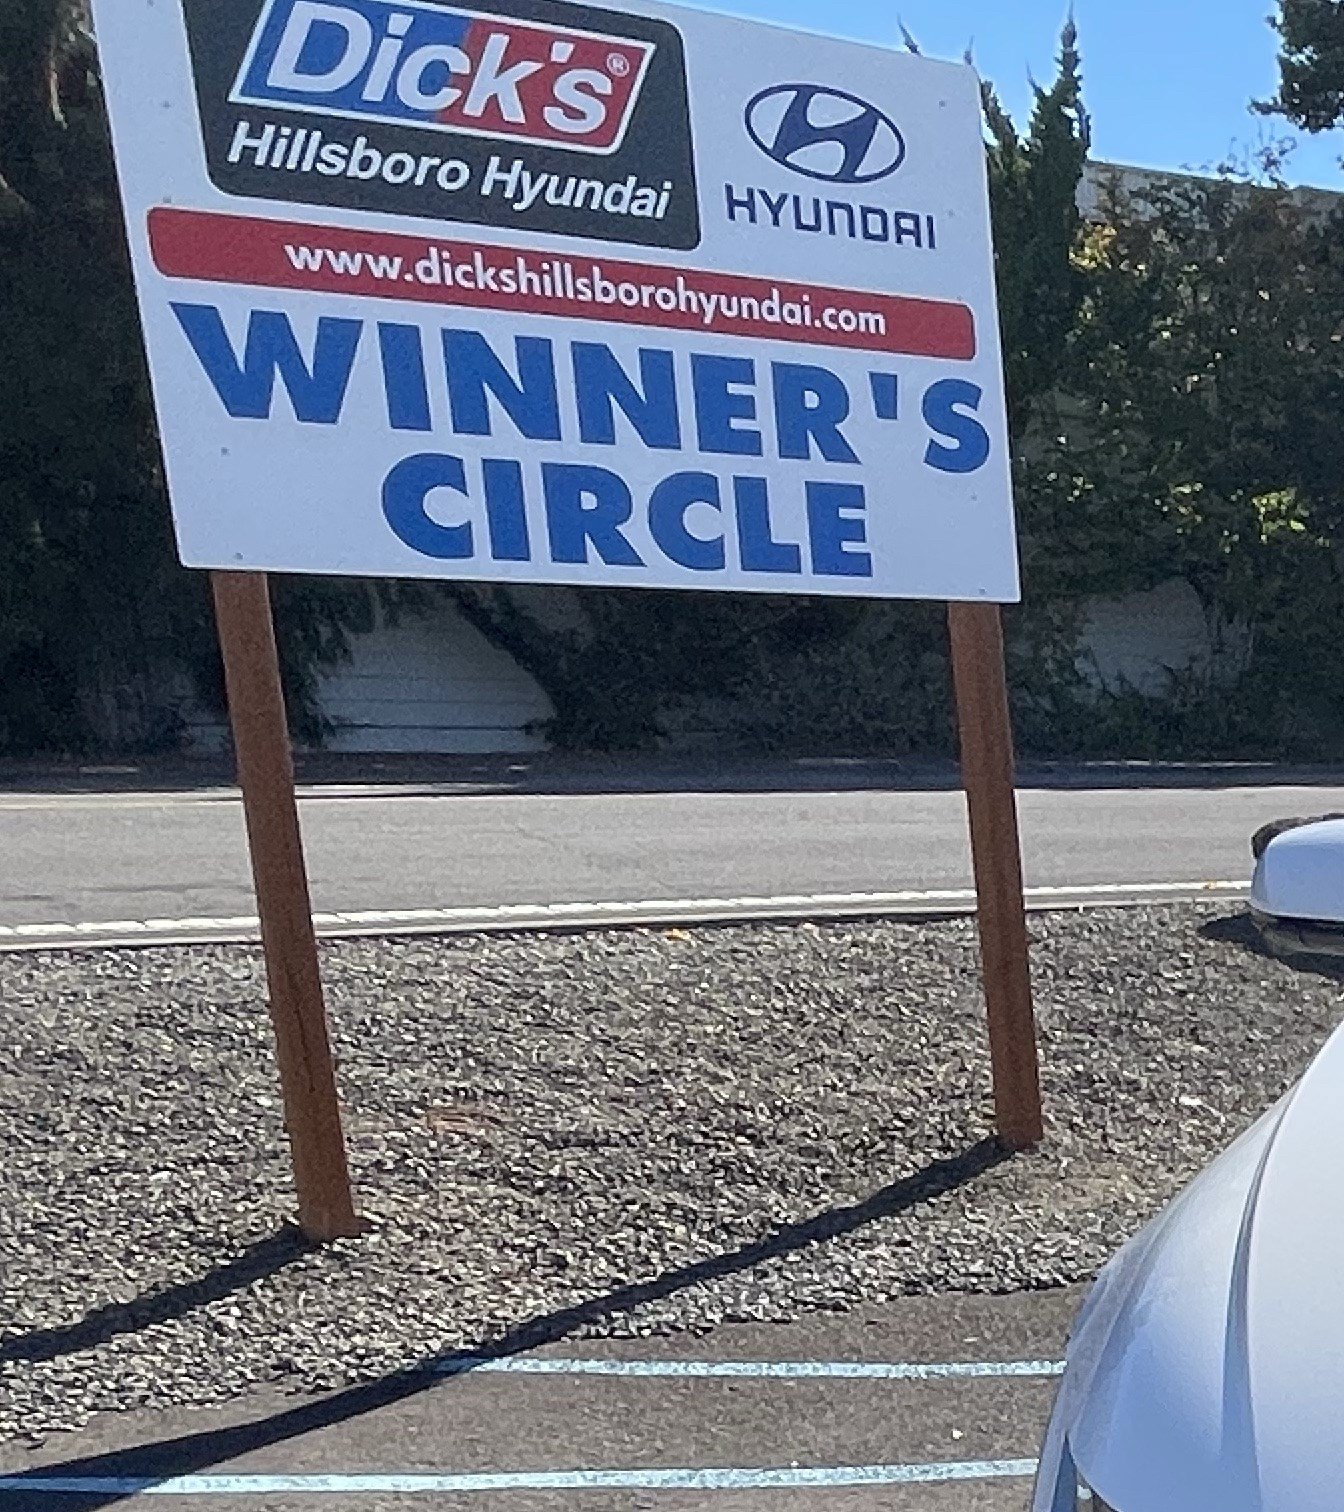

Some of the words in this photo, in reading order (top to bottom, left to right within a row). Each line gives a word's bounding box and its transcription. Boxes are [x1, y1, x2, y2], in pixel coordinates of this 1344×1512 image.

[265, 0, 612, 135] Dick's
[227, 119, 471, 192] Hillsboro
[480, 156, 673, 219] Hyundai
[723, 183, 938, 251] HYUNDAI
[284, 242, 888, 337] www.dickshillsborohyundai.com
[169, 301, 991, 475] WINNER'S
[381, 451, 875, 580] CIRCLE
